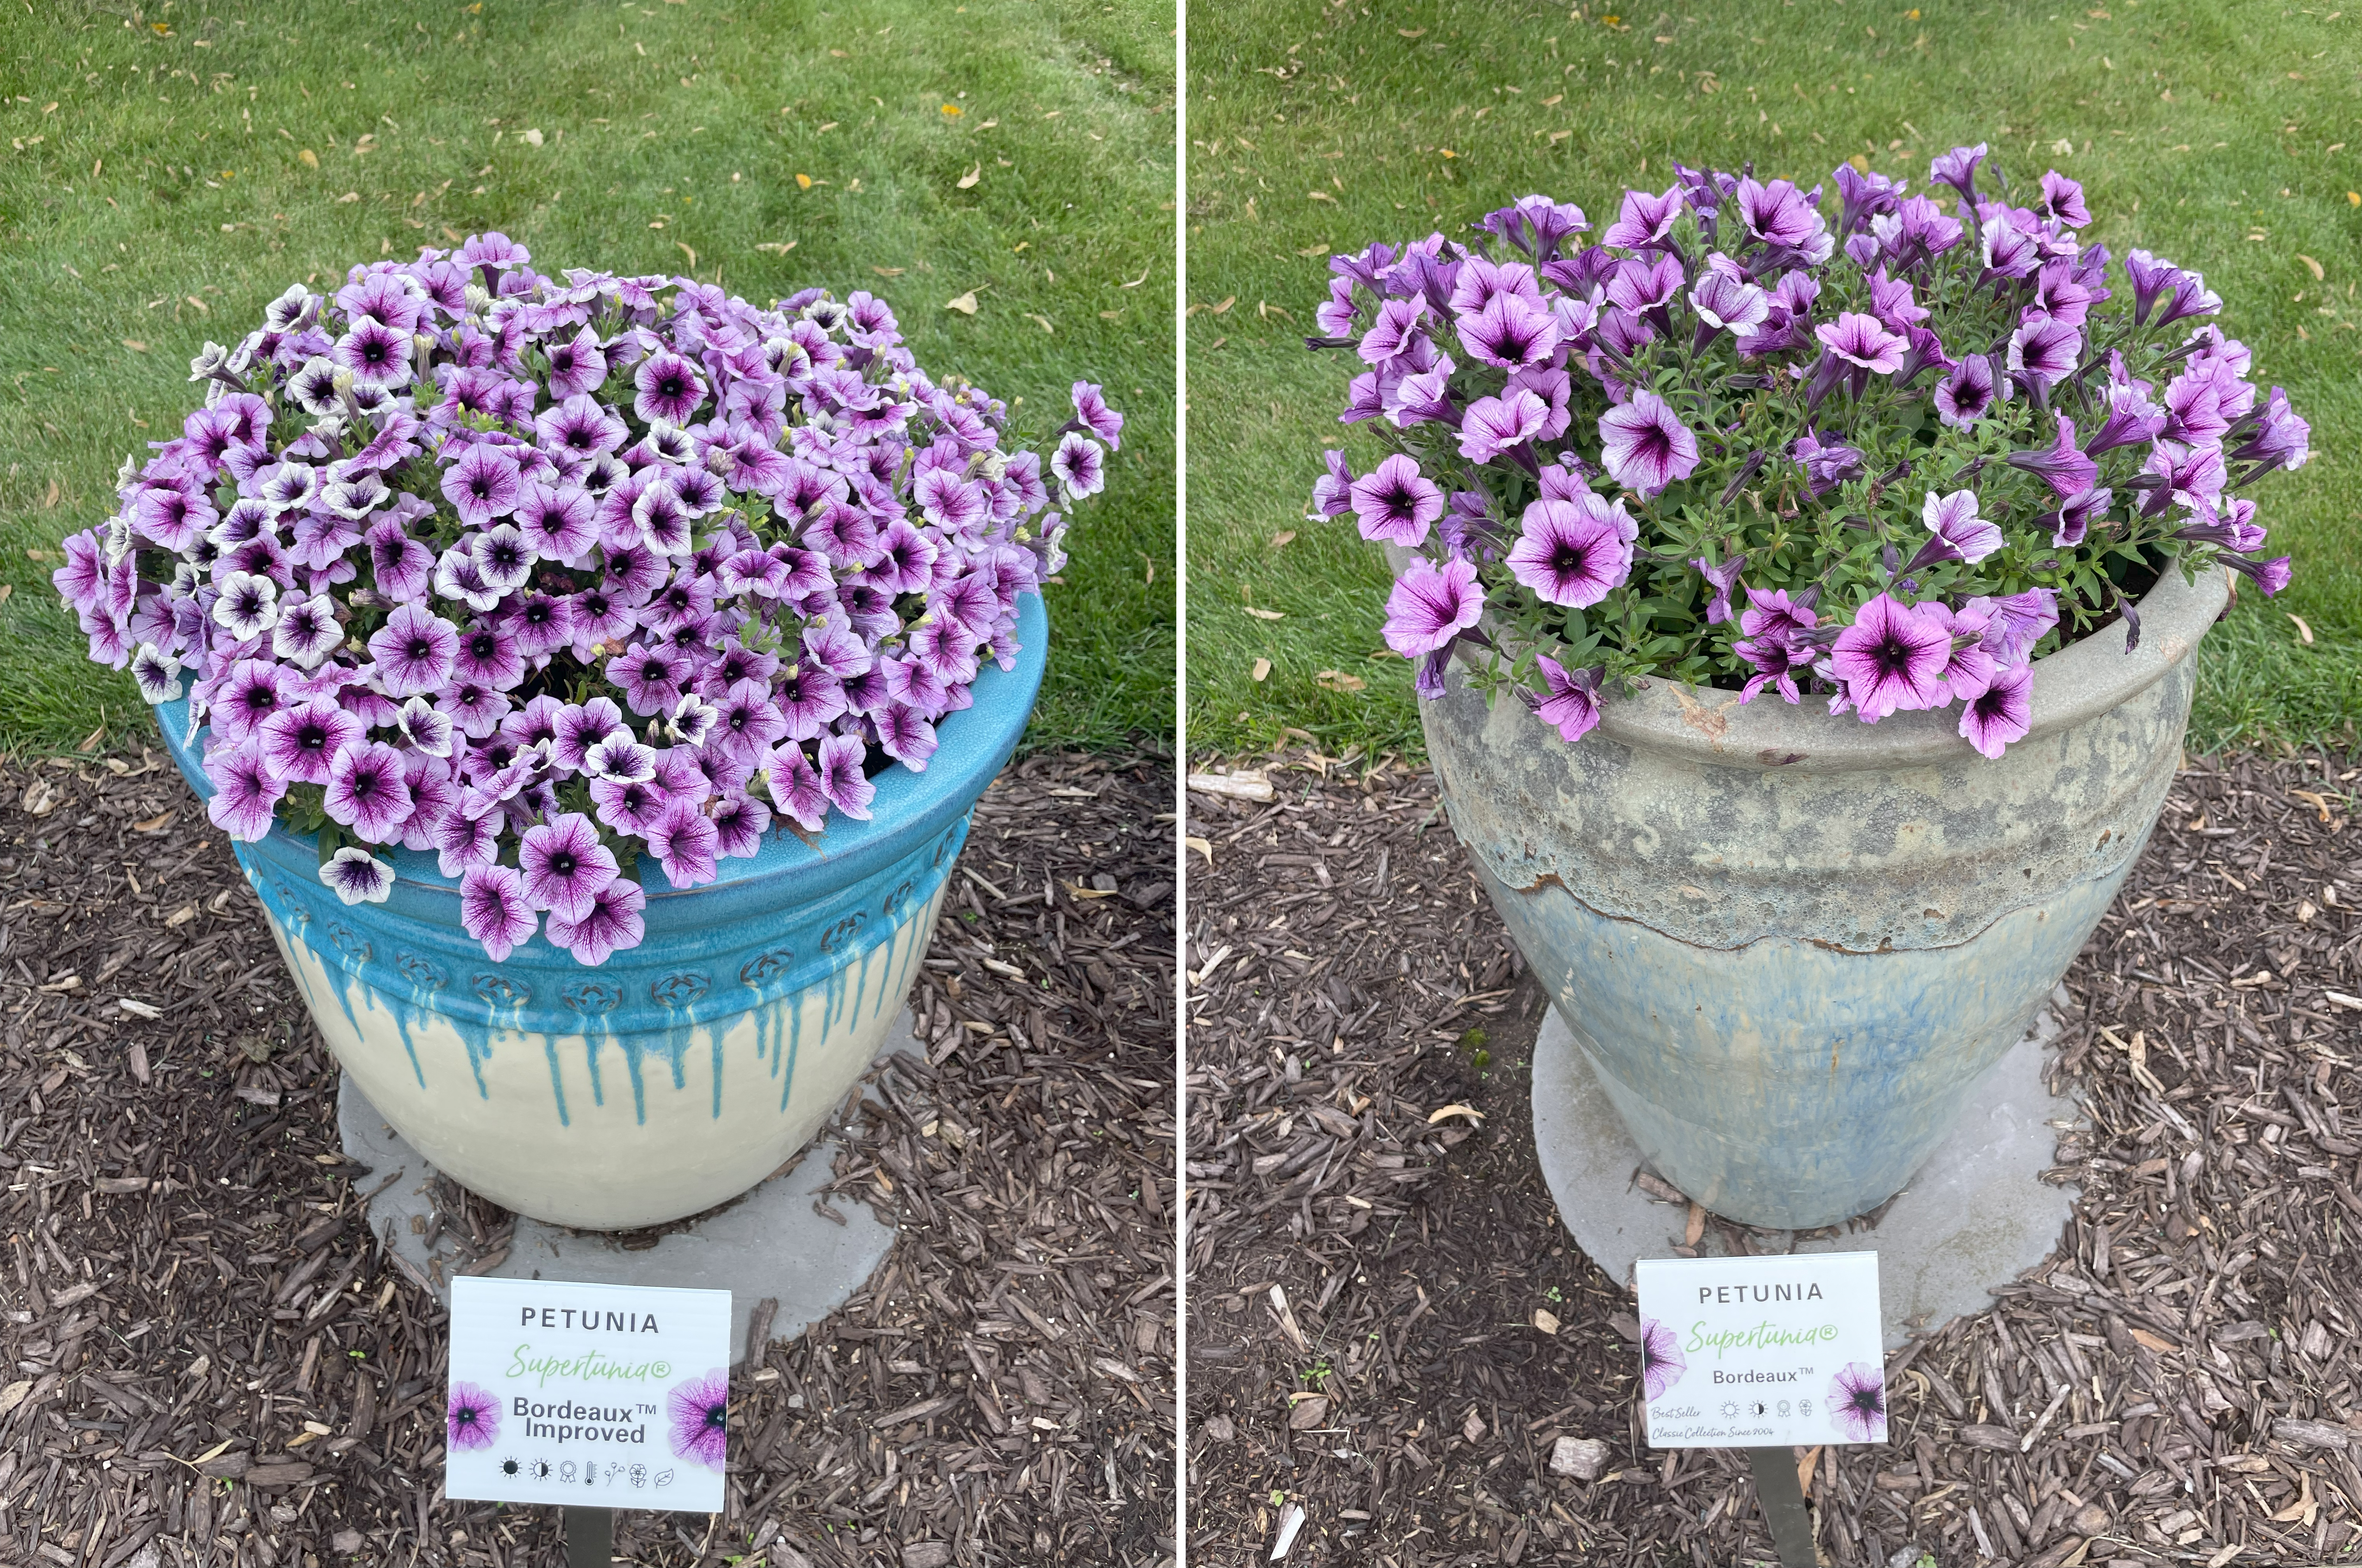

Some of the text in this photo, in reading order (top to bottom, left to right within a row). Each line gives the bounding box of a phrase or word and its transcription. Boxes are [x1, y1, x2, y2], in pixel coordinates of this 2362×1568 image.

[1700, 1283, 1823, 1304] PETUNIA
[522, 1307, 659, 1334] PETUNIA
[1651, 1407, 1701, 1419] Best Seller
[526, 1418, 645, 1443] Improved
[1652, 1426, 1774, 1439] Classic Collection Since 2004
